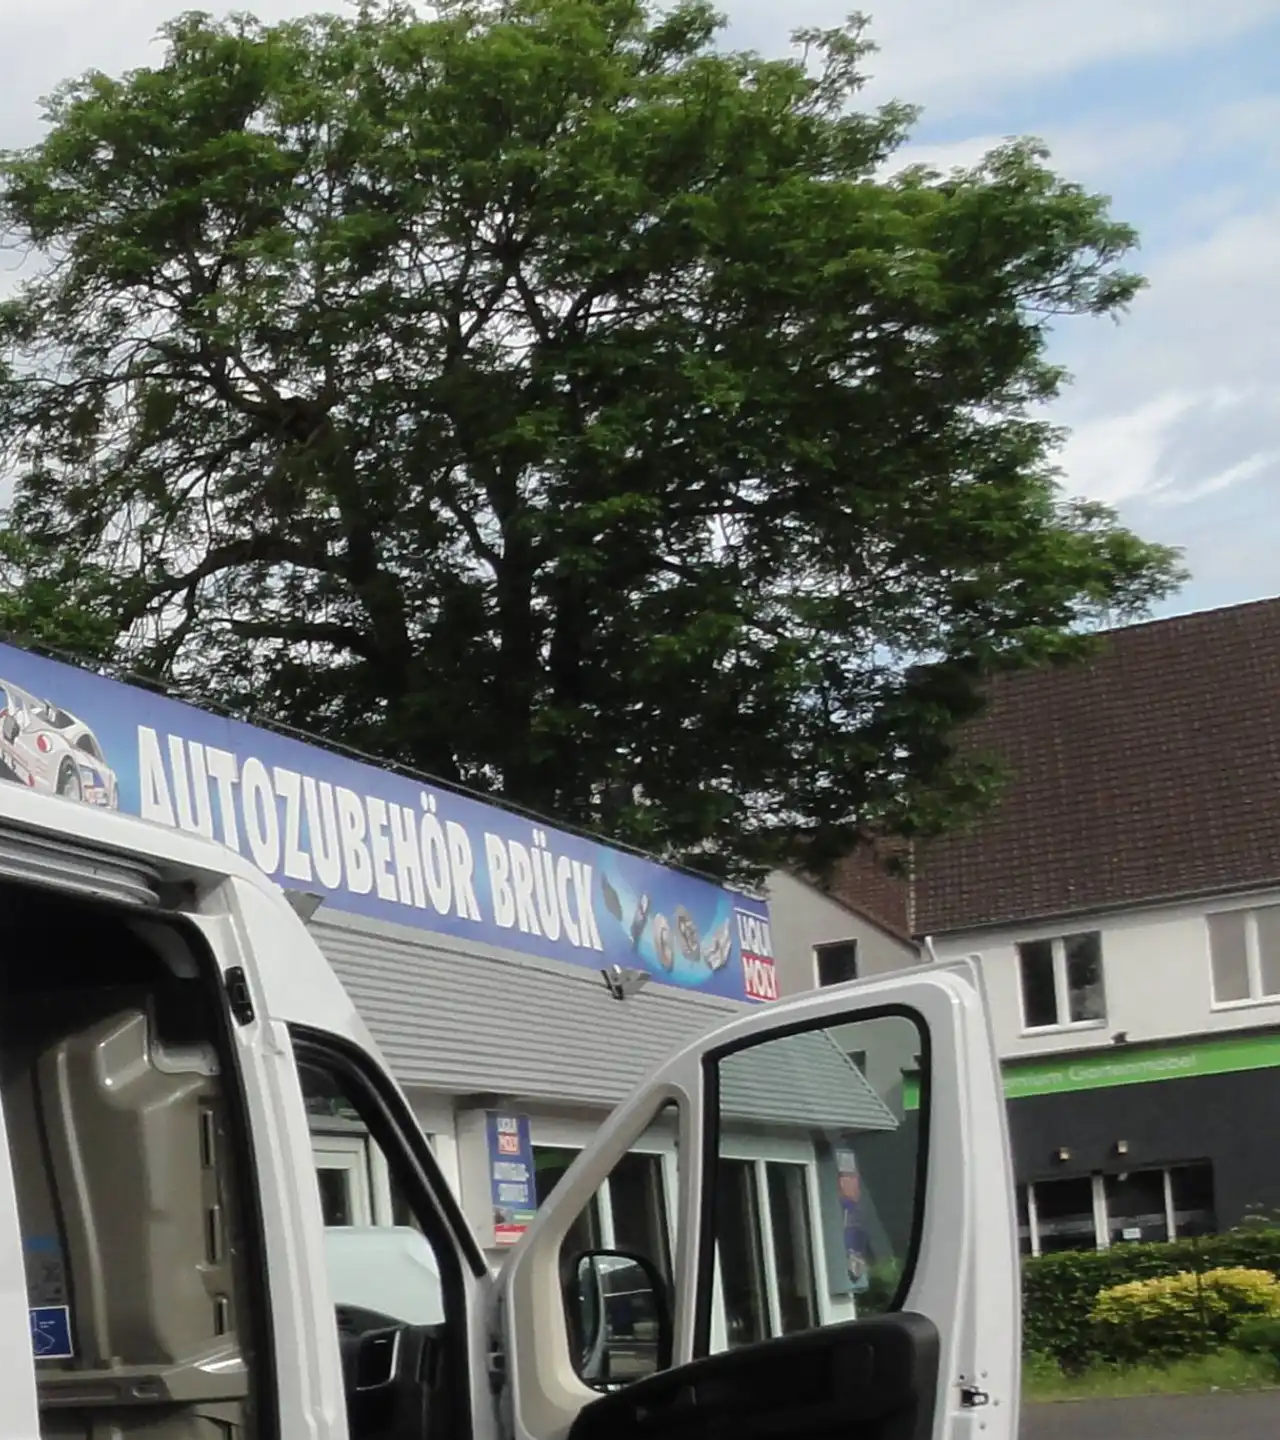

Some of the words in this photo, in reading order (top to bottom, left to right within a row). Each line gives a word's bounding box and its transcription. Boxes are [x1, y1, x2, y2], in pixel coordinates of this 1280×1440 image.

[137, 724, 483, 922] AUTOZUBEHÖR
[483, 828, 605, 951] BRÜCK
[742, 956, 778, 999] MOLY
